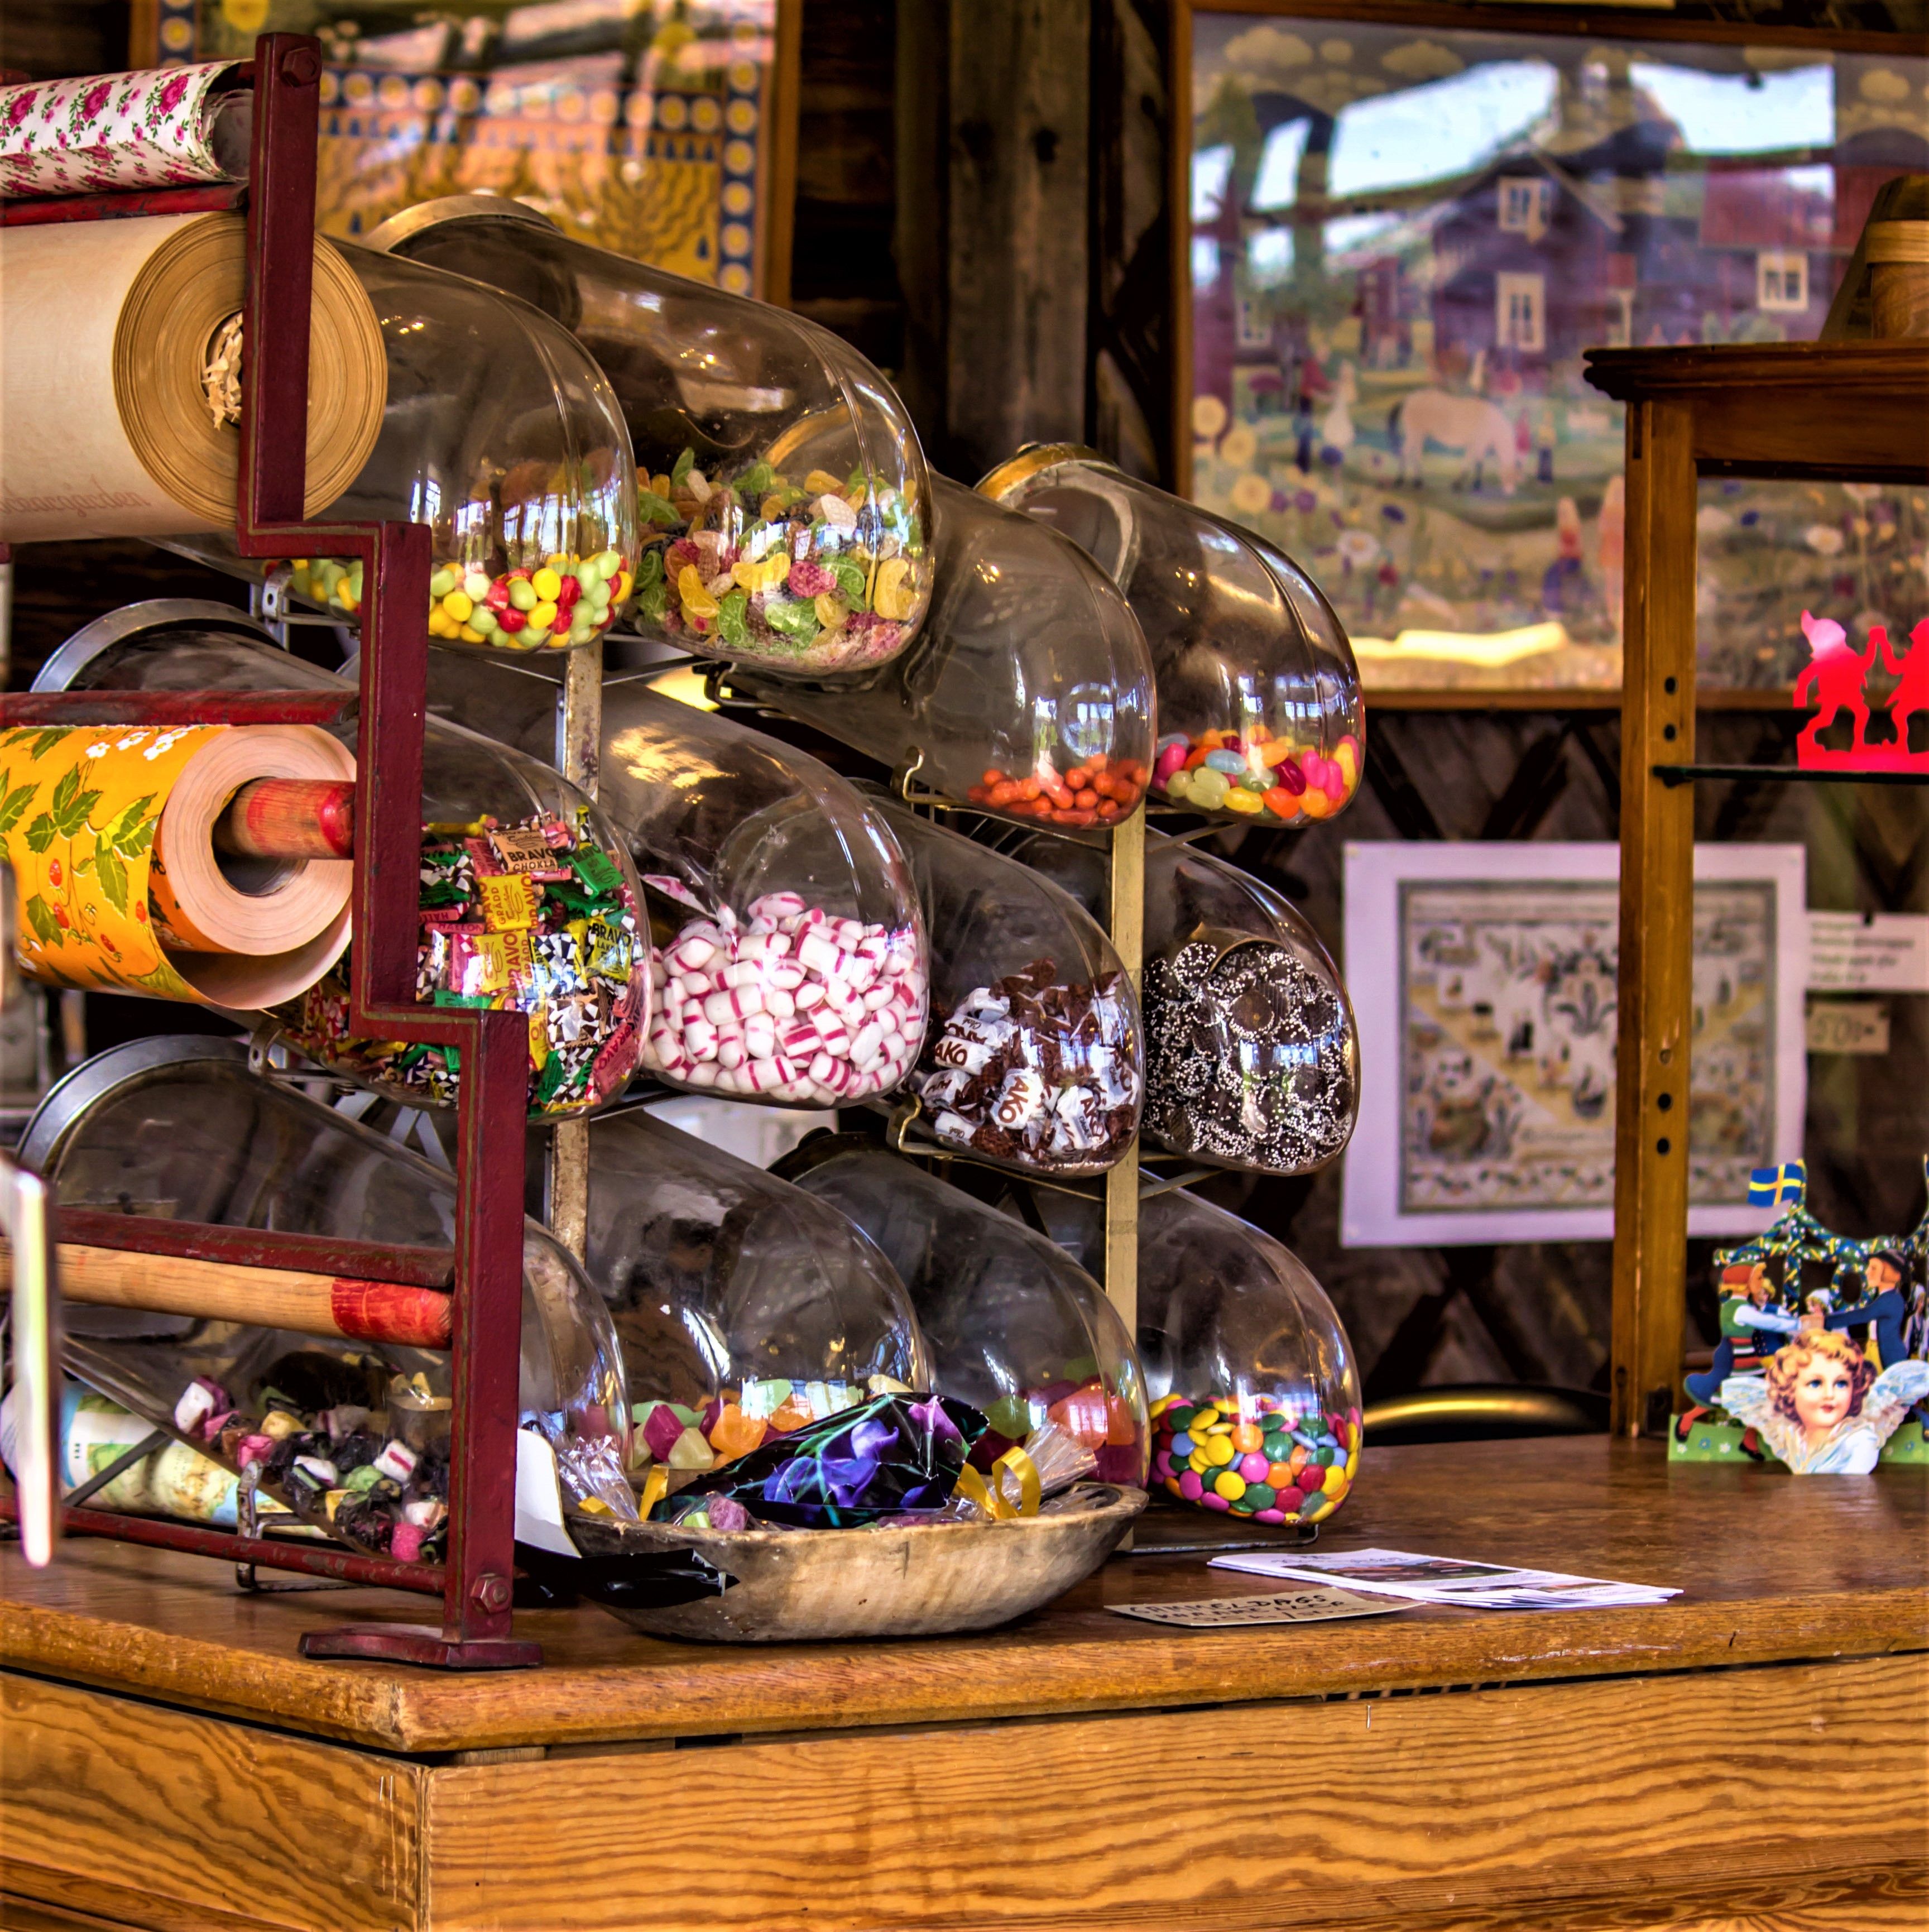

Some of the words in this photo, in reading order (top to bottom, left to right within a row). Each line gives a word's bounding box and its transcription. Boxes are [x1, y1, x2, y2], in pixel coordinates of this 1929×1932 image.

[591, 923, 631, 947] BRAVO
[934, 1041, 968, 1066] AKO
[998, 1076, 1035, 1124] AKO
